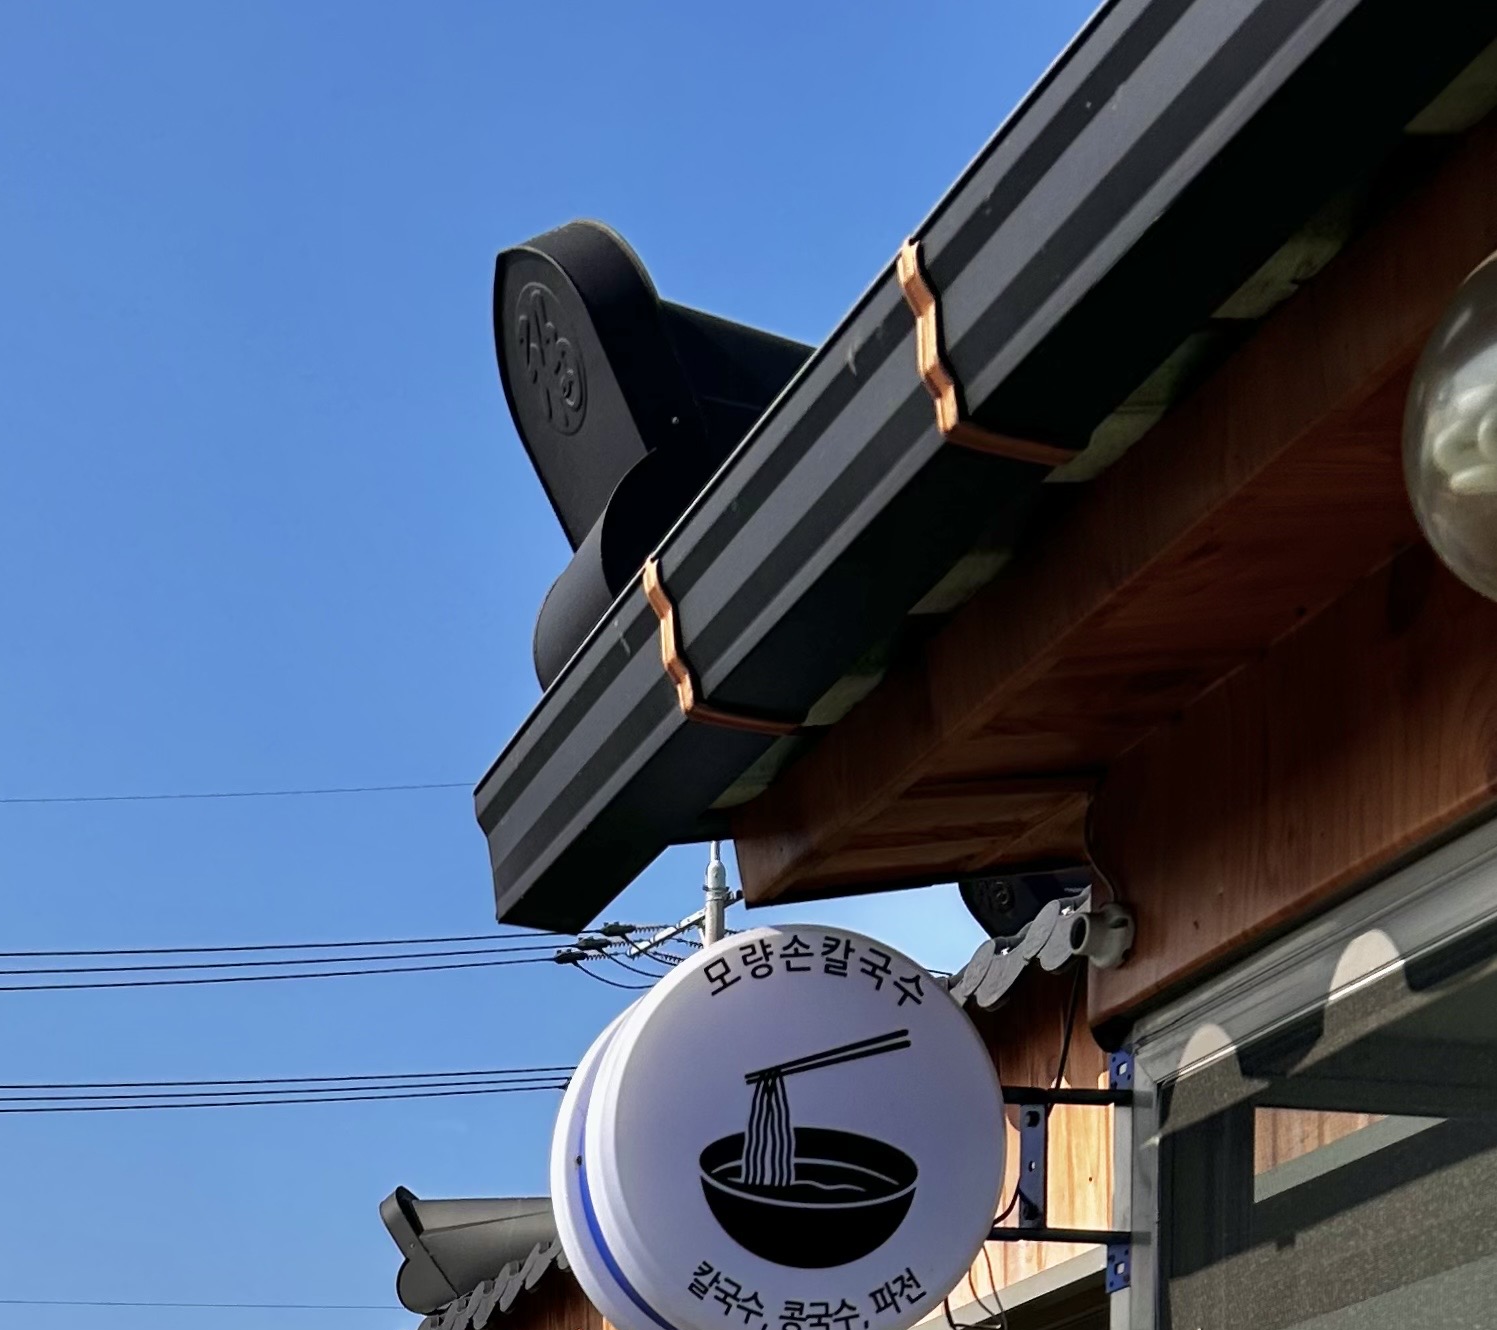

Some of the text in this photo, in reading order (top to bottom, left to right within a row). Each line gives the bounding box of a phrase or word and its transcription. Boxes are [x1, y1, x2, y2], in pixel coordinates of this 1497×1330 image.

[704, 935, 925, 1006] 모량손칼국수
[688, 1261, 768, 1330] 칼국수,
[869, 1267, 927, 1314] 파전
